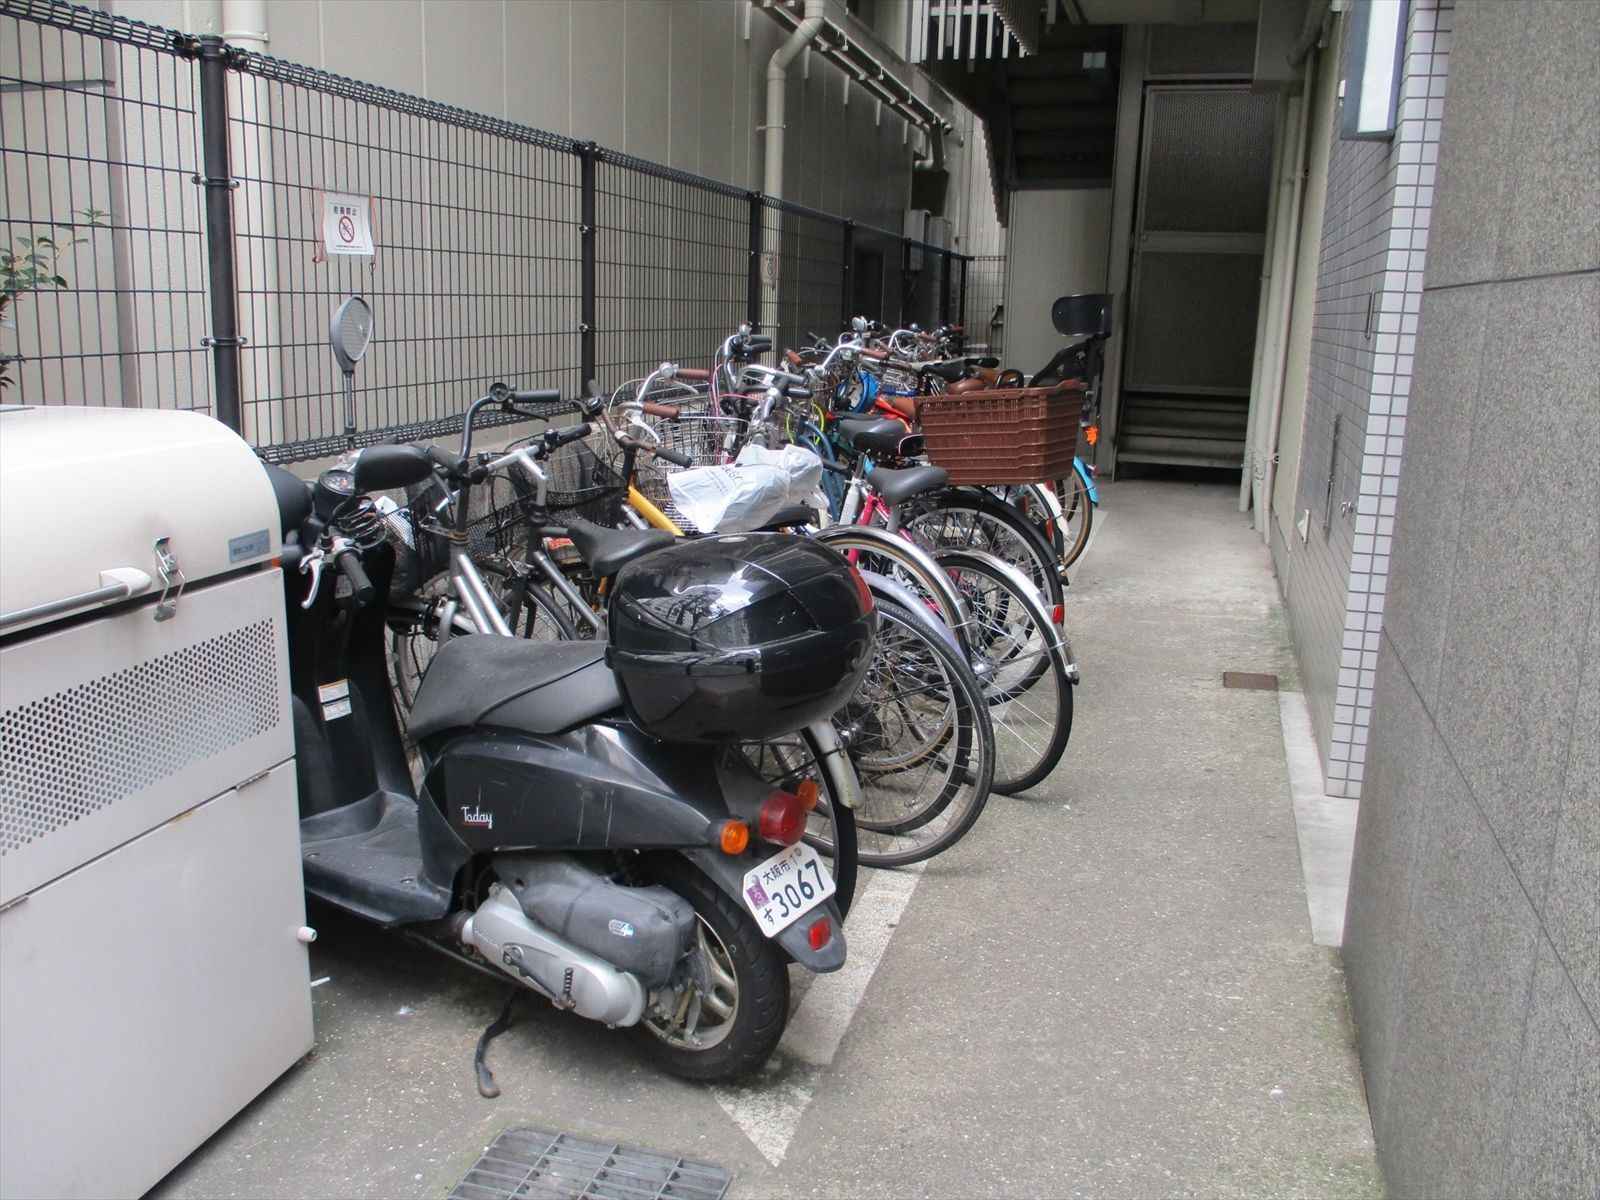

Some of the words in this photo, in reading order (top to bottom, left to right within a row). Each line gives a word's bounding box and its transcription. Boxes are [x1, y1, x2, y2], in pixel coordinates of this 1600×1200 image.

[460, 806, 493, 830] Today
[763, 860, 791, 885] 大阪市
[763, 907, 775, 926] す
[771, 858, 825, 918] 3067
